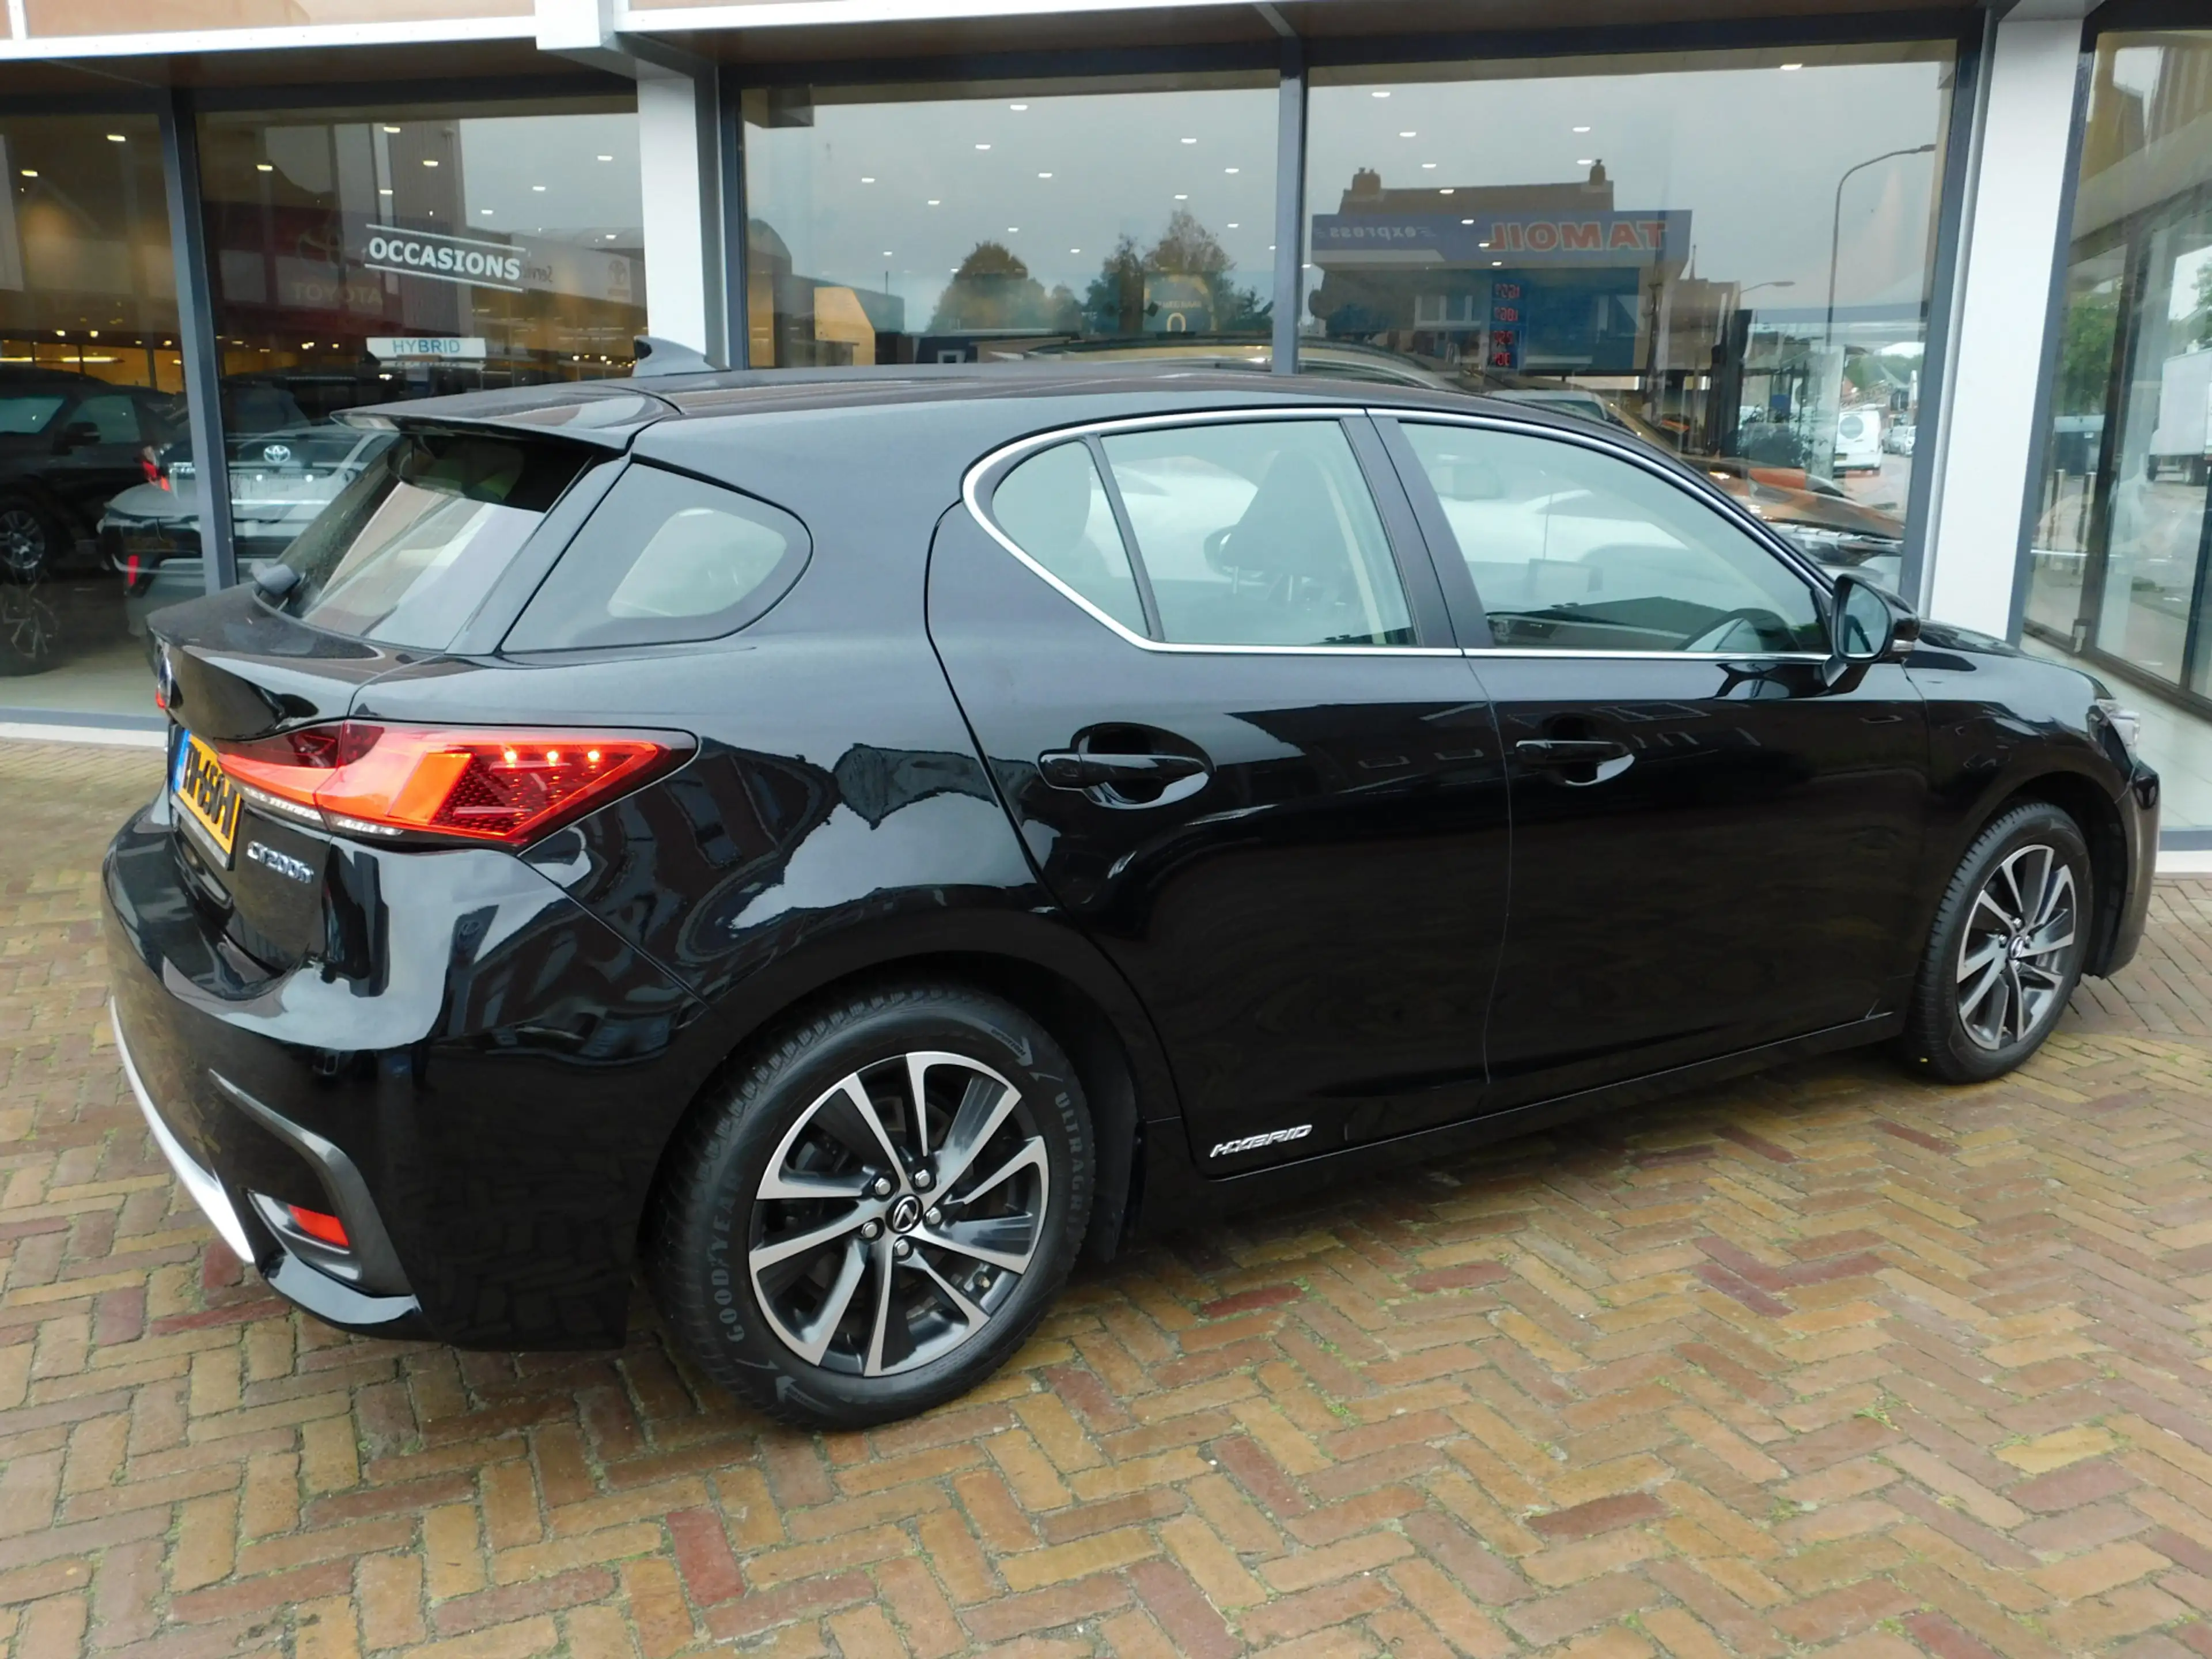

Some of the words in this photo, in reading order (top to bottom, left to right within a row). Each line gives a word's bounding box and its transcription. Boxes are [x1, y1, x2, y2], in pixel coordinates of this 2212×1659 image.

[369, 237, 520, 280] OCCASIONS
[392, 339, 460, 353] HYBRID
[1210, 1124, 1313, 1158] HYBRID
[710, 1172, 745, 1343] GOODYEAR
